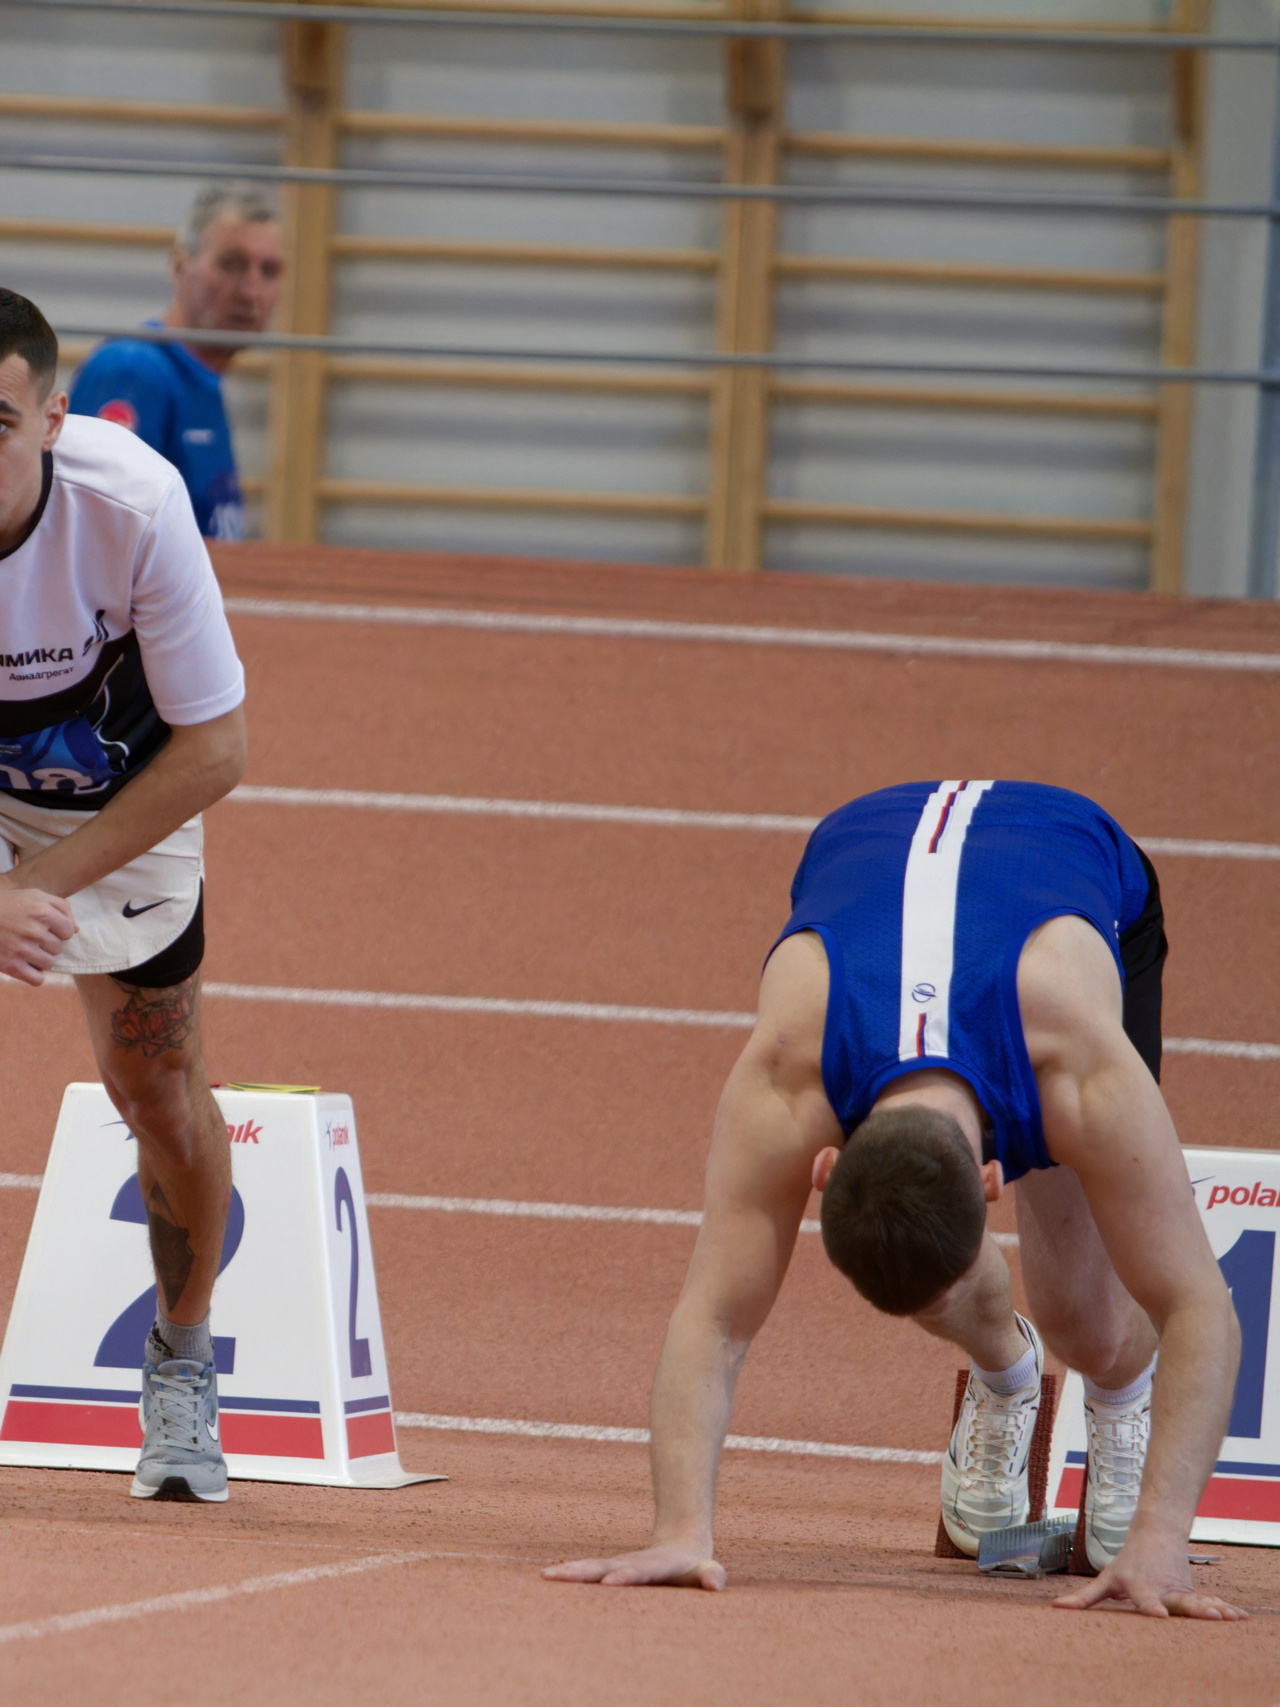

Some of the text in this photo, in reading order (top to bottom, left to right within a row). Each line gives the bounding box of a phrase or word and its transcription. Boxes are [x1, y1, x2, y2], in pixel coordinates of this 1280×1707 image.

[93, 1167, 245, 1375] 2
[334, 1166, 372, 1378] 2
[1217, 1229, 1276, 1439] 1
